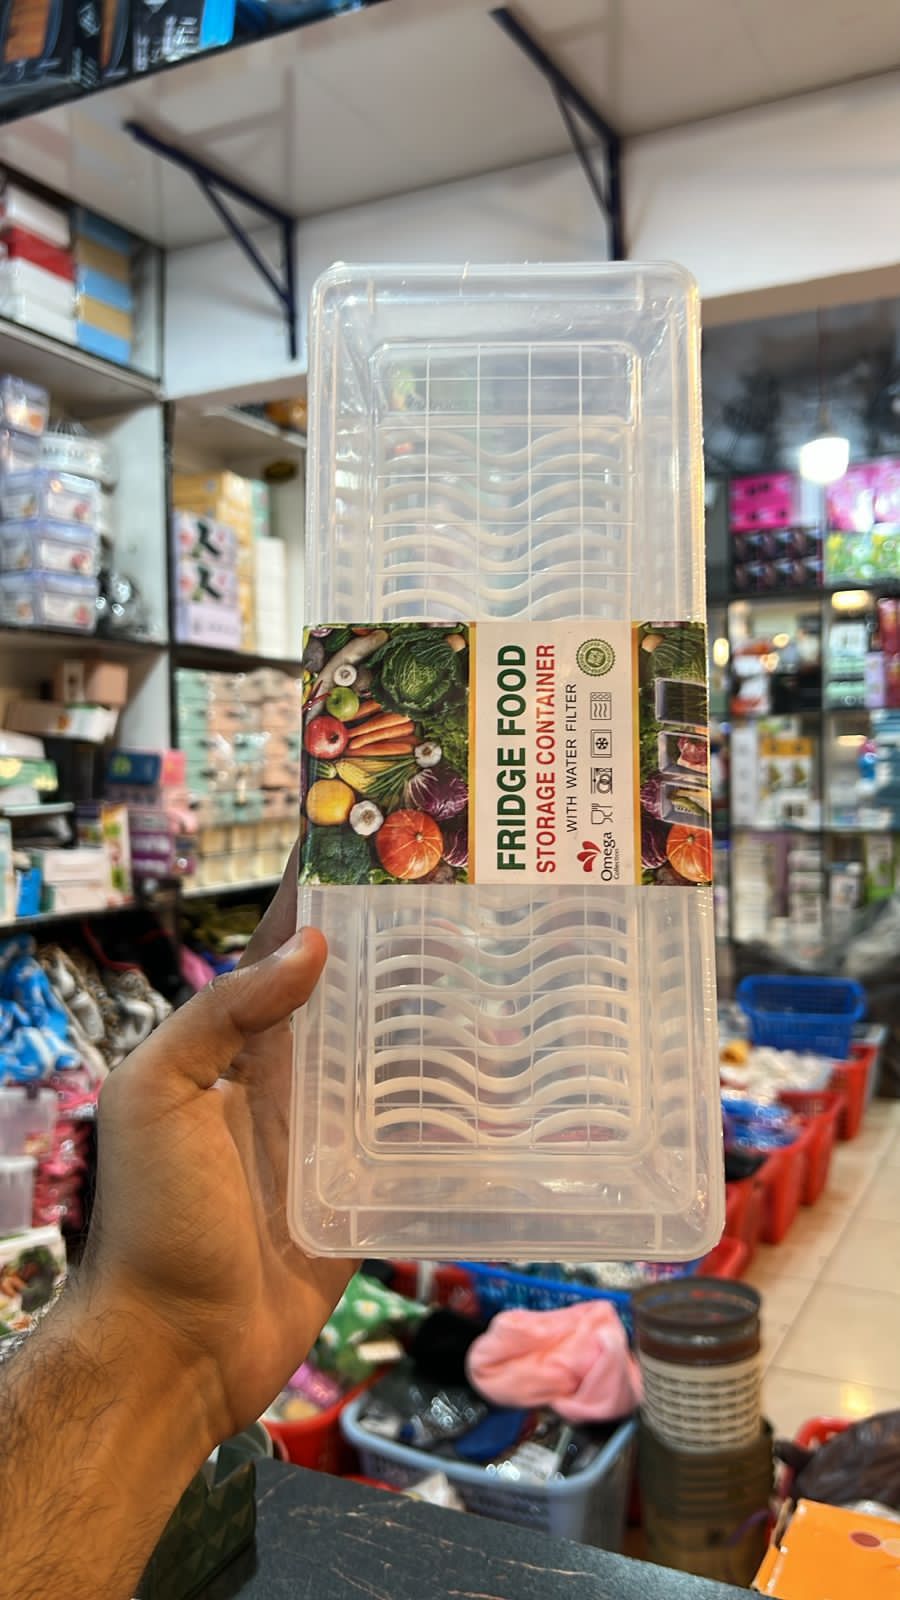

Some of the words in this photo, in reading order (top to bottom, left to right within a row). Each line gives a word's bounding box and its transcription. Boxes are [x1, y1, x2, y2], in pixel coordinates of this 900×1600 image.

[496, 644, 526, 736] FOOD
[535, 644, 556, 765] CONTAINER
[565, 683, 577, 732] FILTER
[566, 739, 577, 788] WATER
[496, 747, 526, 871] FRIDGE
[536, 772, 556, 873] STORAGE
[566, 796, 577, 832] WITH
[601, 832, 616, 882] Omega
